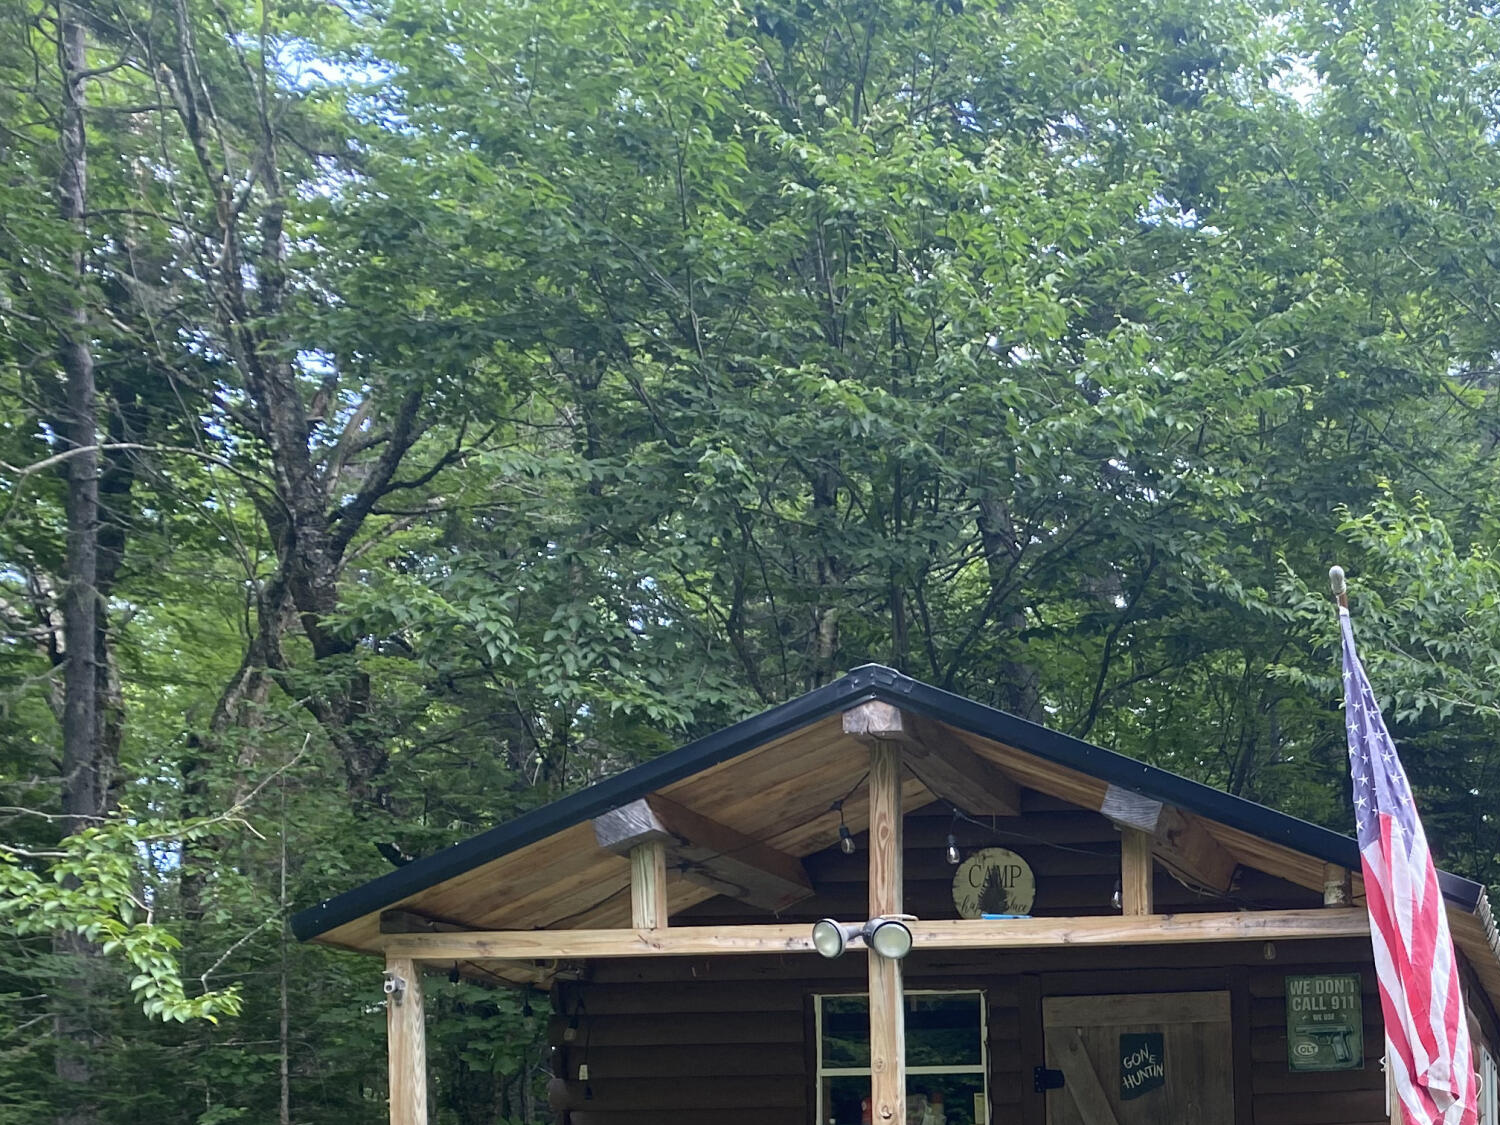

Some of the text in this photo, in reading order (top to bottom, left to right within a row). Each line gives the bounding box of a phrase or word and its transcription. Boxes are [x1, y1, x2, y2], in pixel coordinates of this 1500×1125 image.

[1290, 979, 1355, 995] WE DON'T
[1292, 996, 1355, 1011] CALL 911
[1123, 1042, 1157, 1069] GONE
[1123, 1061, 1164, 1089] HUNTIN
